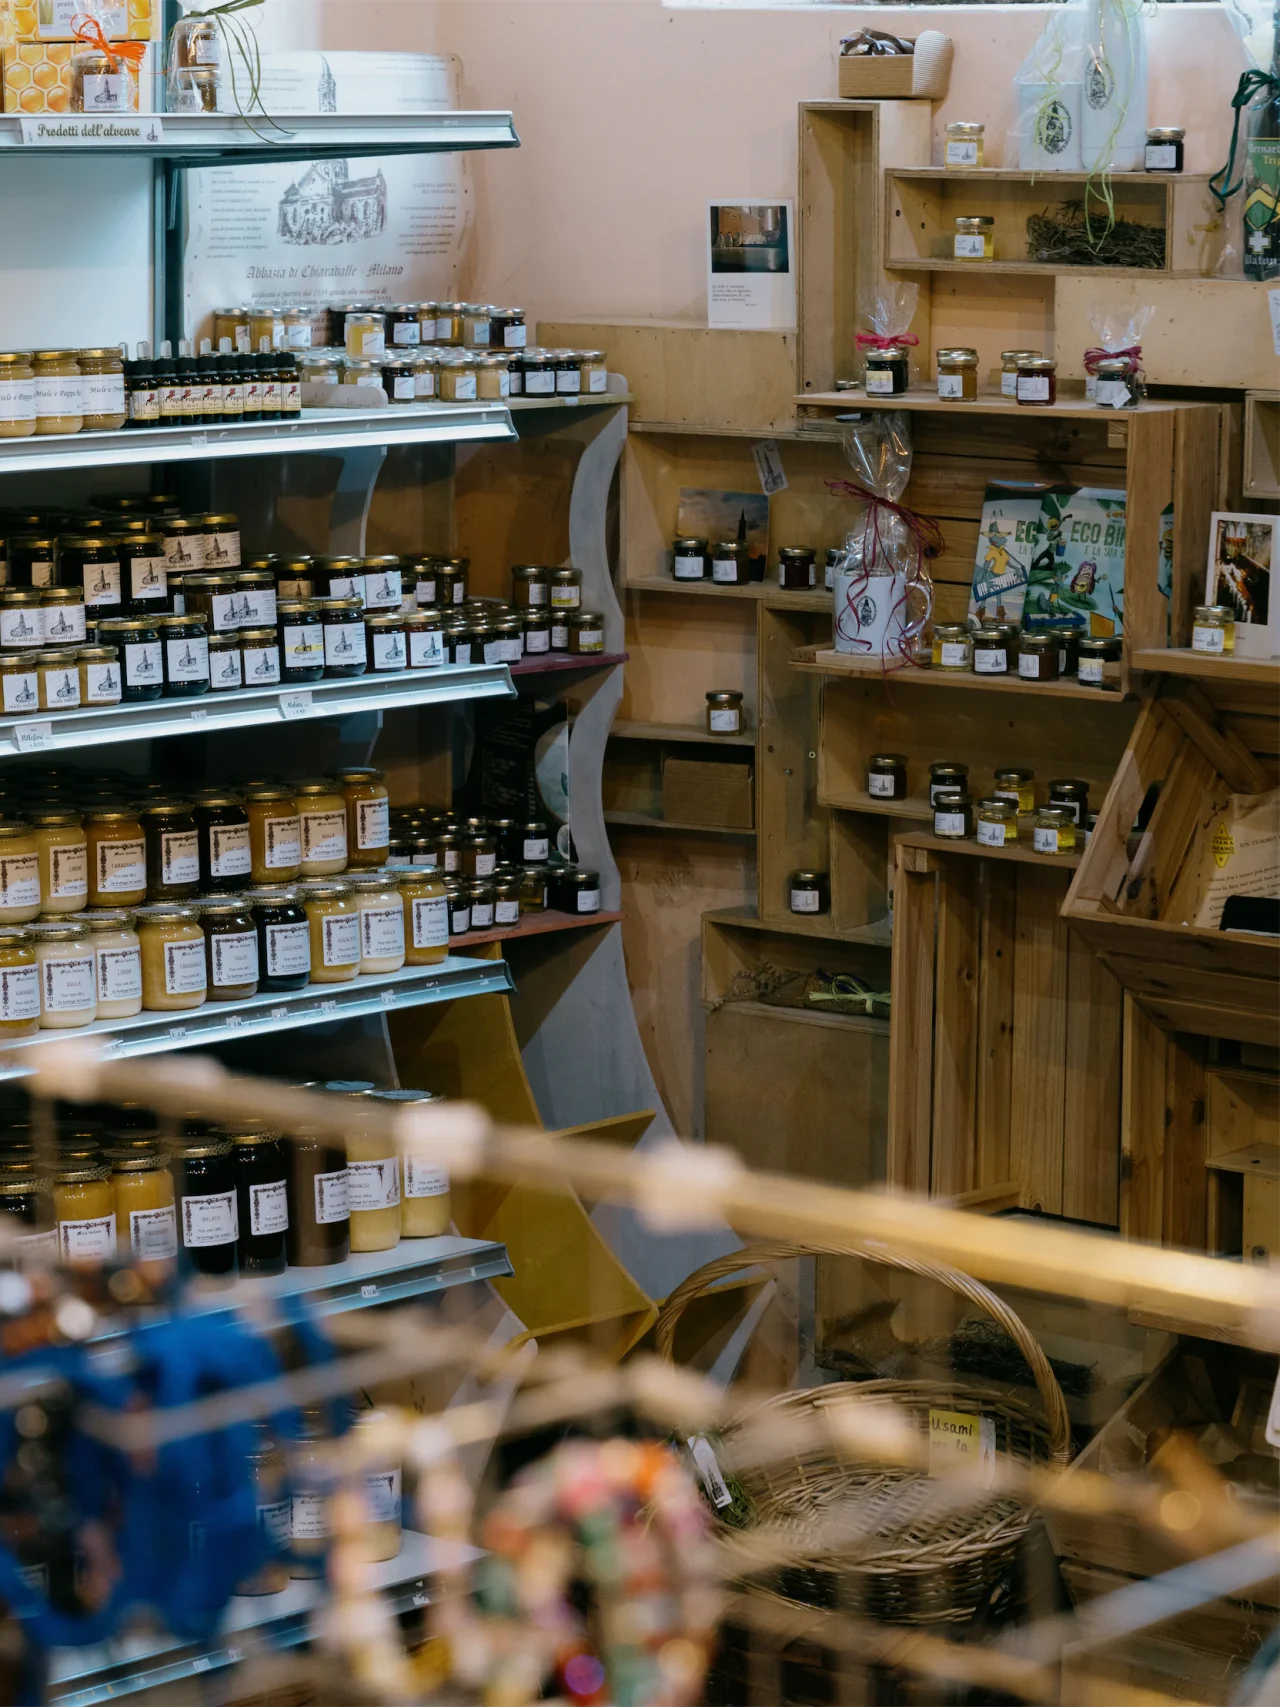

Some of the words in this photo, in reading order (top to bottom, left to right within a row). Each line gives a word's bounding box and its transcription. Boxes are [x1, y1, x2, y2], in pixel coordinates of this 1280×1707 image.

[37, 123, 79, 138] Prodotti
[81, 124, 140, 137] dell'alveare
[245, 265, 286, 279] Abbazia
[288, 265, 299, 278] di
[300, 264, 358, 278] Chiaravalle
[366, 265, 404, 278] Milano
[34, 390, 52, 398] Miele
[88, 386, 107, 394] Miele
[1070, 520, 1102, 545] ECO
[1092, 545, 1101, 556] LA
[931, 1417, 973, 1437] Usami
